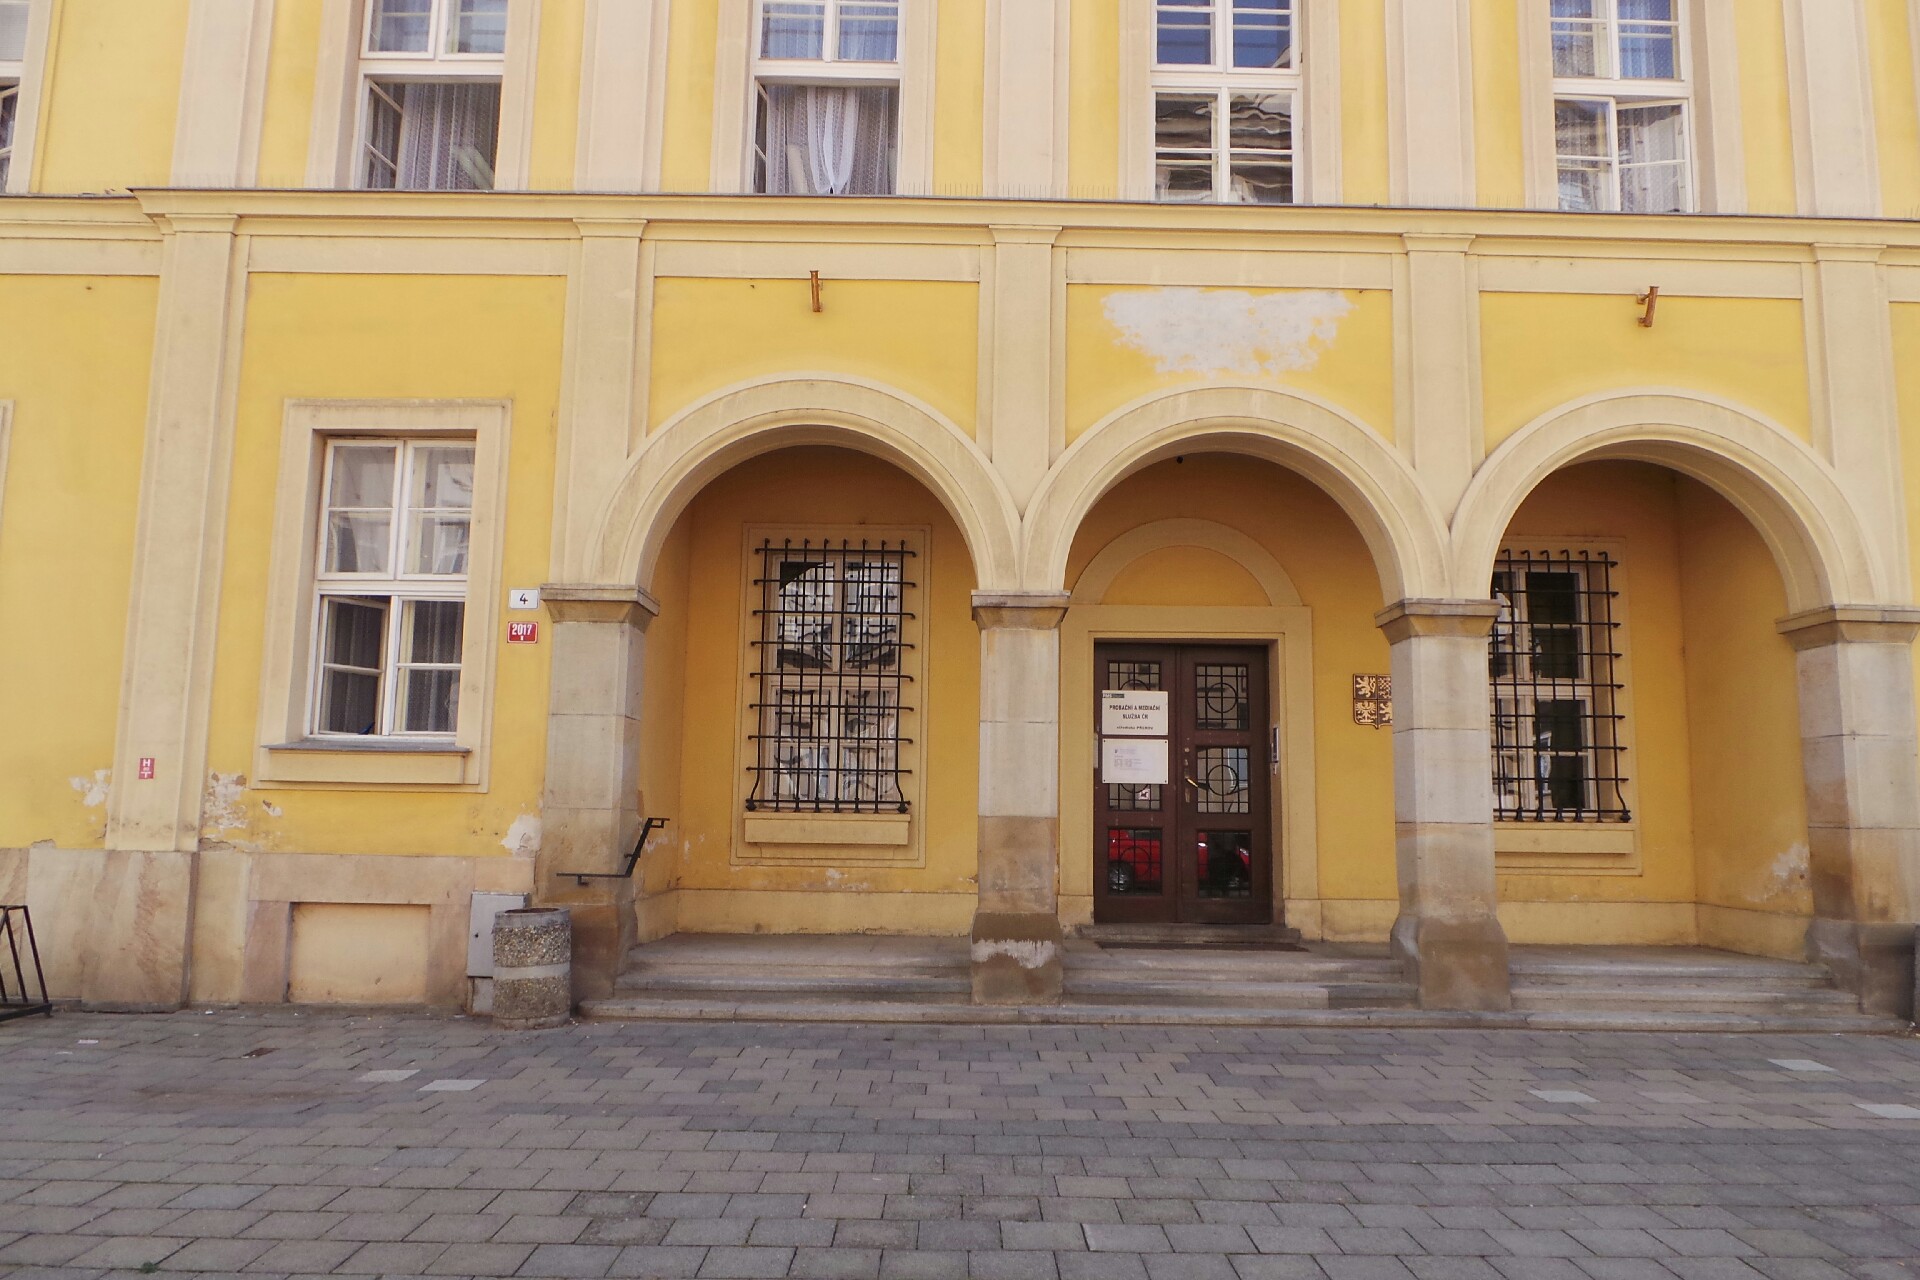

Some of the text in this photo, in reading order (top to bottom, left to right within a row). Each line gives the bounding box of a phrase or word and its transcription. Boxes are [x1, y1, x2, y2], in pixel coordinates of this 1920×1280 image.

[519, 593, 529, 605] 4
[511, 623, 533, 636] 2017
[143, 758, 151, 767] H
